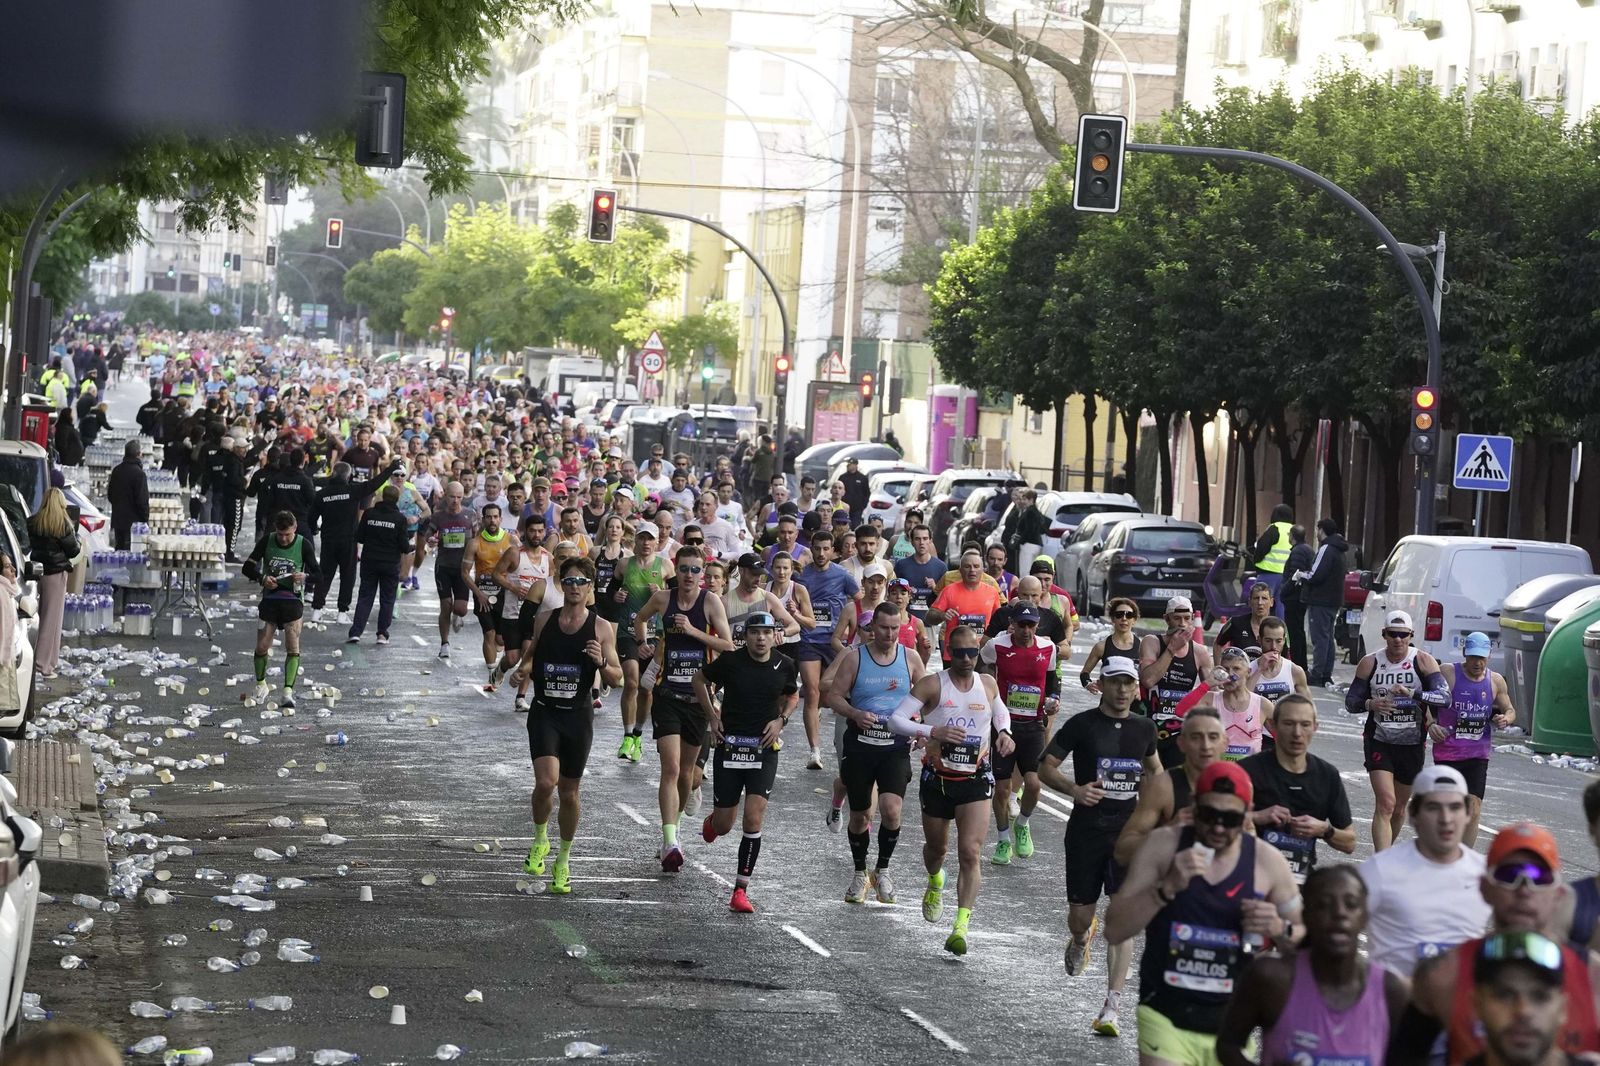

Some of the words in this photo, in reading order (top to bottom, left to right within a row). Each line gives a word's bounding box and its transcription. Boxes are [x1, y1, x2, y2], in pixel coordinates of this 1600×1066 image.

[646, 357, 660, 367] 30
[322, 493, 350, 503] VOLUNTEER
[367, 519, 396, 529] VOLUNTEER
[673, 667, 702, 676] ALFRED
[1375, 672, 1414, 685] UNED
[547, 681, 556, 690] DE
[557, 682, 578, 691] DIEGO
[1010, 700, 1036, 709] RICHARD
[1393, 714, 1414, 722] PROFE
[864, 729, 892, 739] THIERRY
[731, 753, 755, 762] PABLO
[949, 752, 970, 763] KEITH
[1113, 760, 1140, 769] ZURICH
[1102, 780, 1136, 791] VINCENT
[1281, 835, 1308, 847] ZURICH
[1176, 958, 1229, 978] CARLOS
